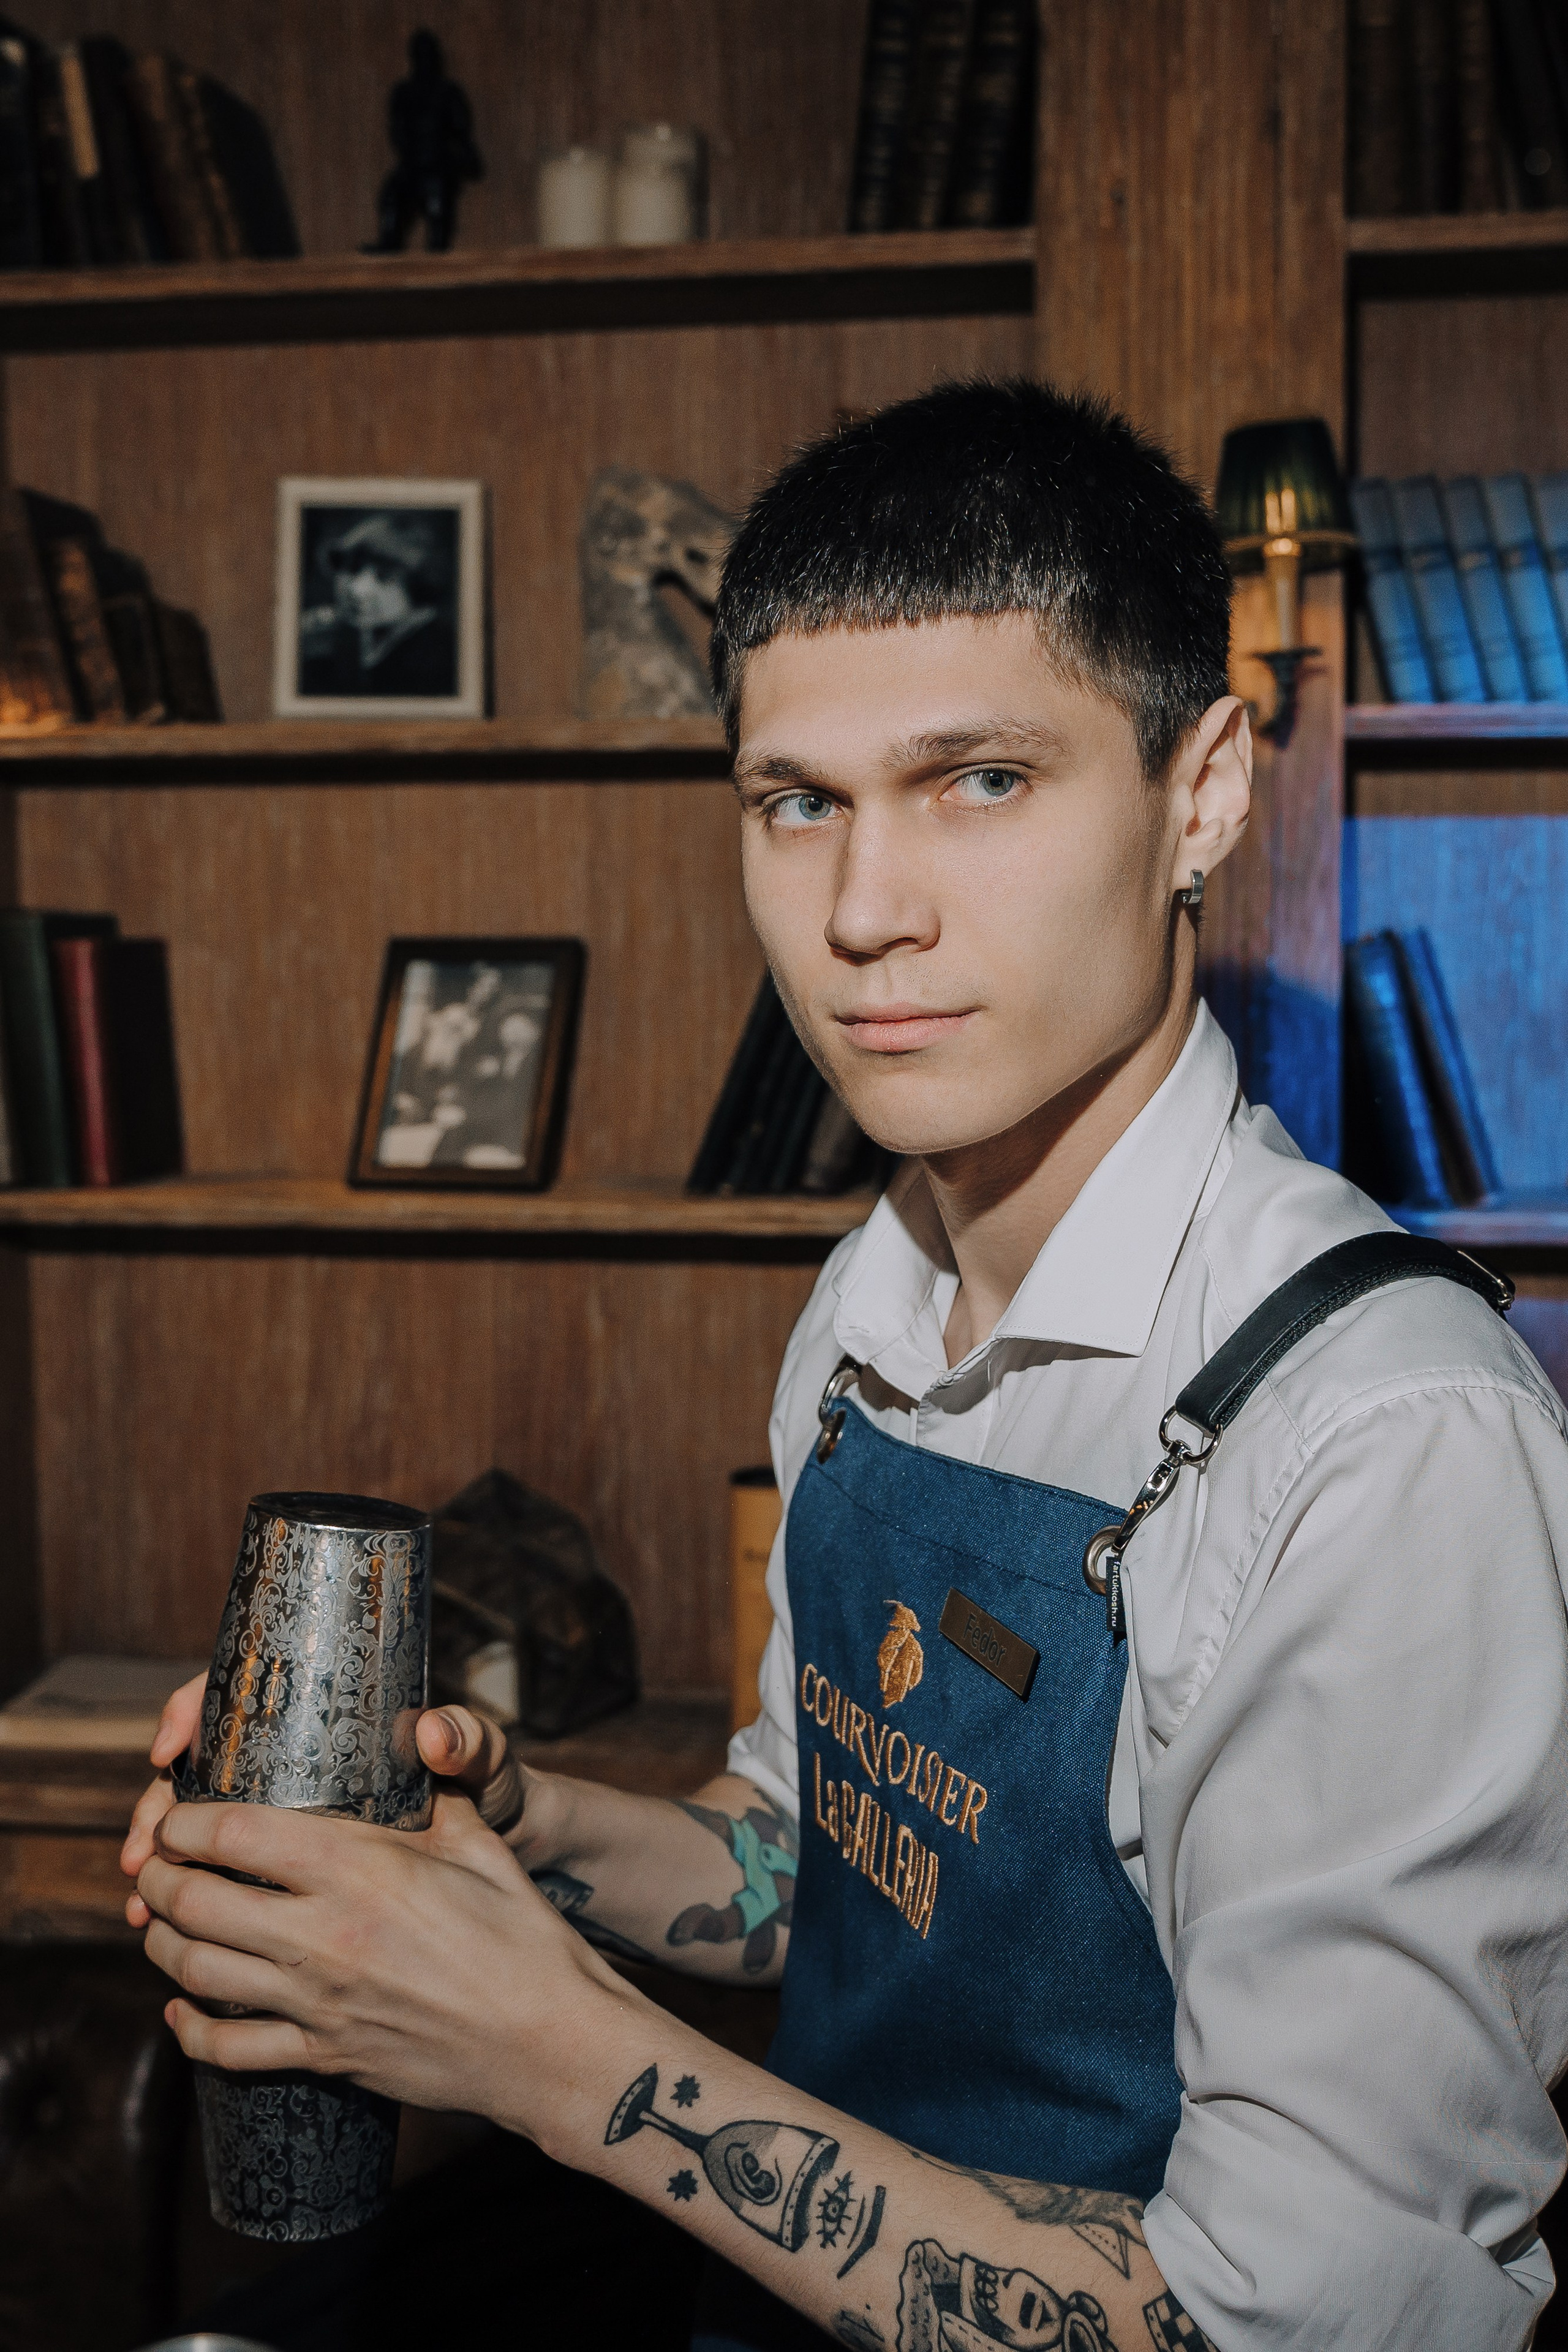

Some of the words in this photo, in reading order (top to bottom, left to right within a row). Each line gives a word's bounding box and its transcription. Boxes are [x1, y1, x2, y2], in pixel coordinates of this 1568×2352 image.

[1112, 1561, 1120, 1626] fartukkosh.ru
[963, 1612, 1007, 1667] Fedor
[801, 1664, 987, 1844] COURVOISIER
